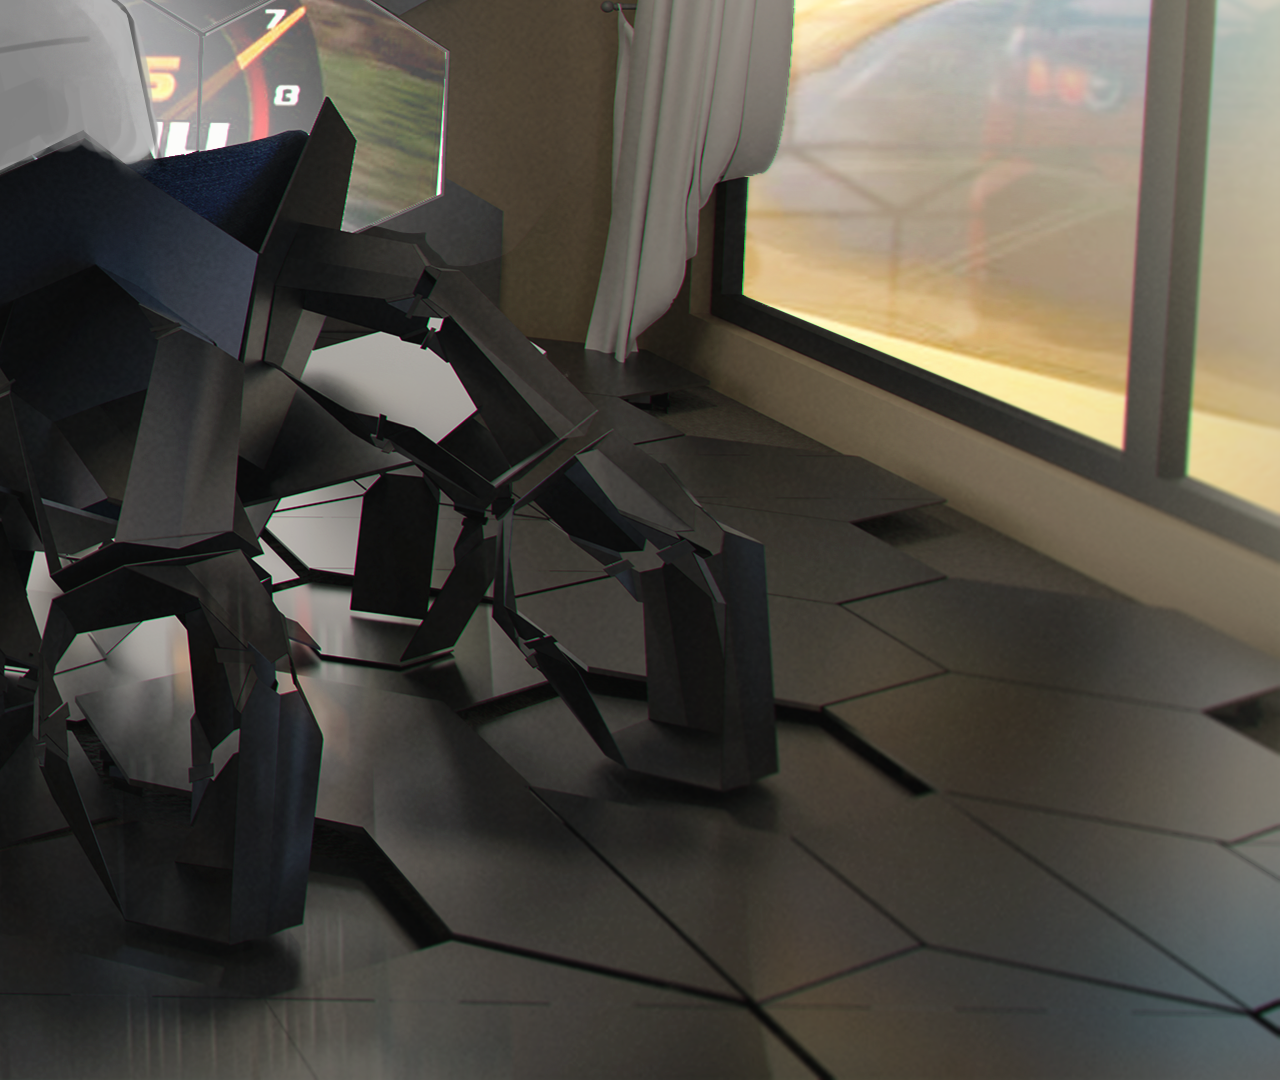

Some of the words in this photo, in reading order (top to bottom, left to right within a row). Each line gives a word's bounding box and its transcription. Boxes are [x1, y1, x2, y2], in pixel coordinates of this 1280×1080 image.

[265, 9, 287, 30] 7
[146, 56, 181, 102] 5
[274, 85, 300, 106] 8
